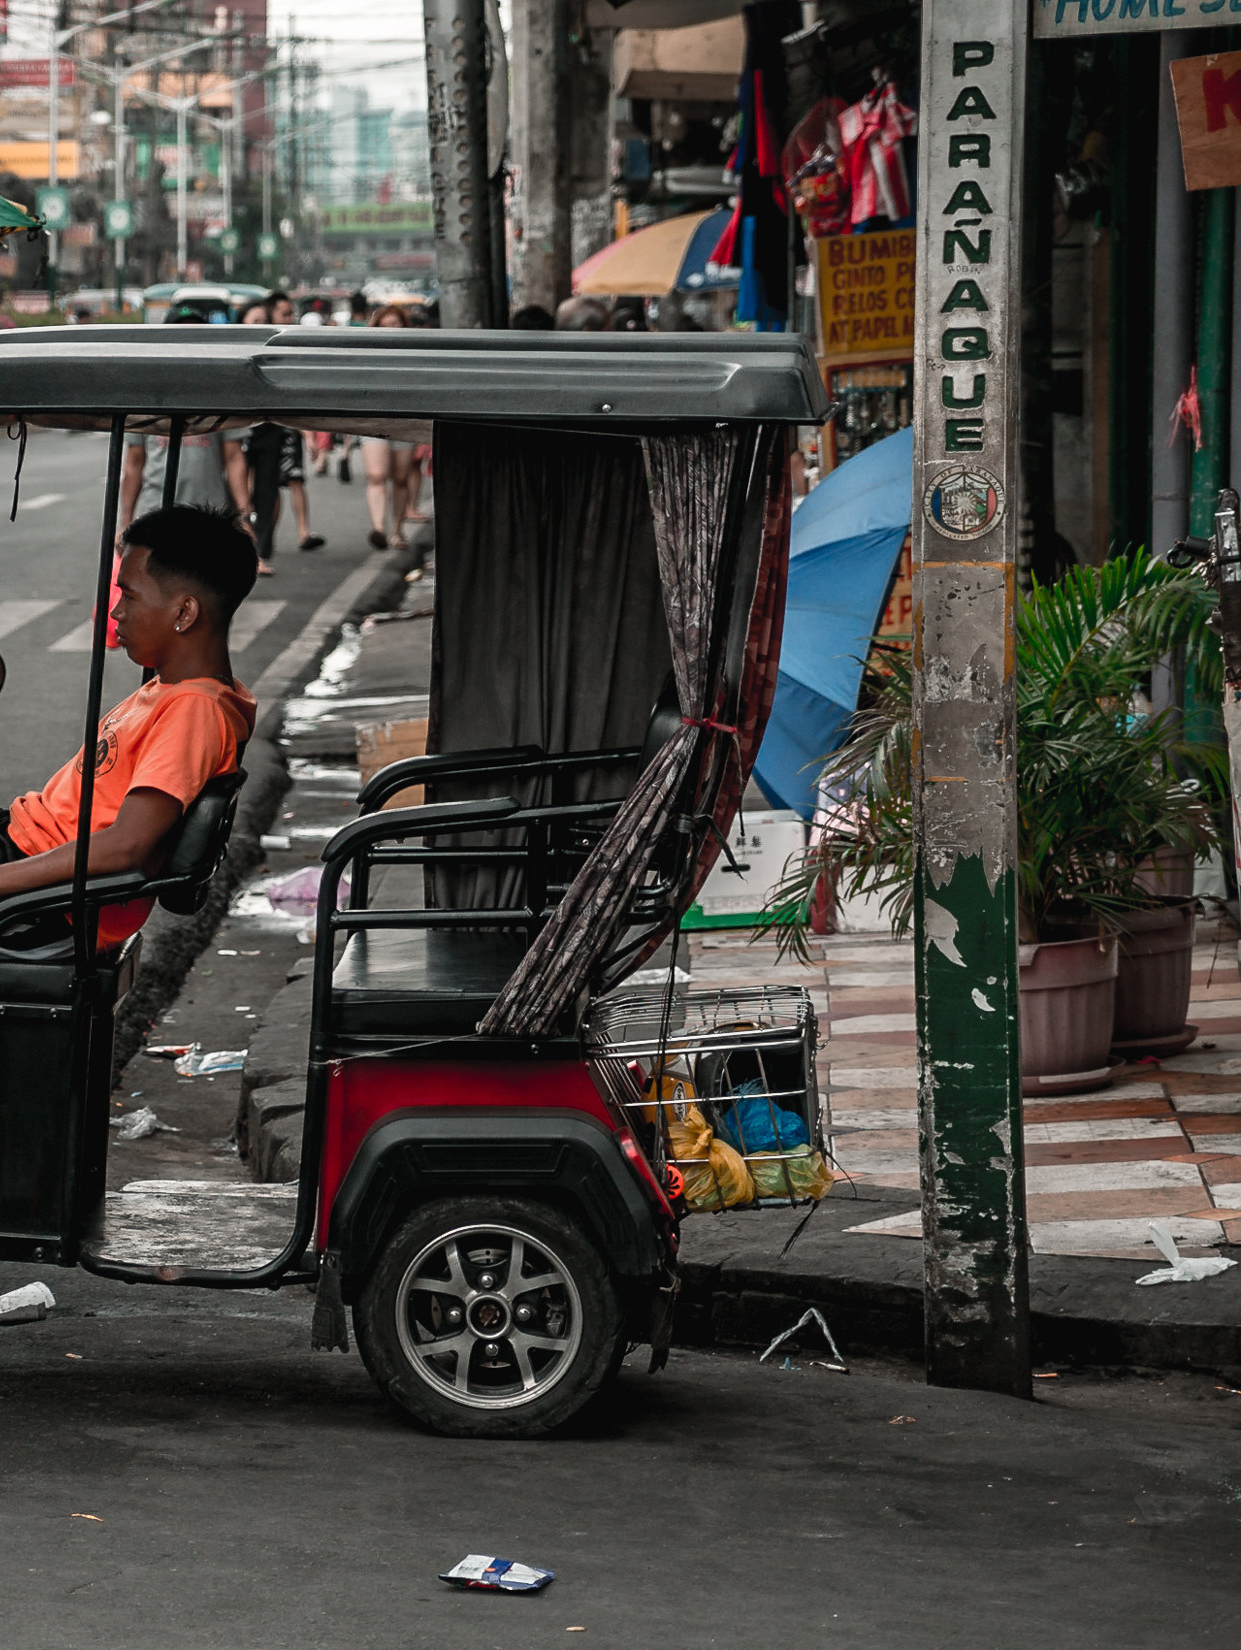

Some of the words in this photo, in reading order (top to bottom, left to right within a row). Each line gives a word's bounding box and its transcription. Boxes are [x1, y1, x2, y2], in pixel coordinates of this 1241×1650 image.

[828, 234, 916, 268] BUMIB
[940, 41, 996, 453] PARAÑAQUE
[832, 265, 885, 290] GINTO
[833, 289, 888, 316] RELOS
